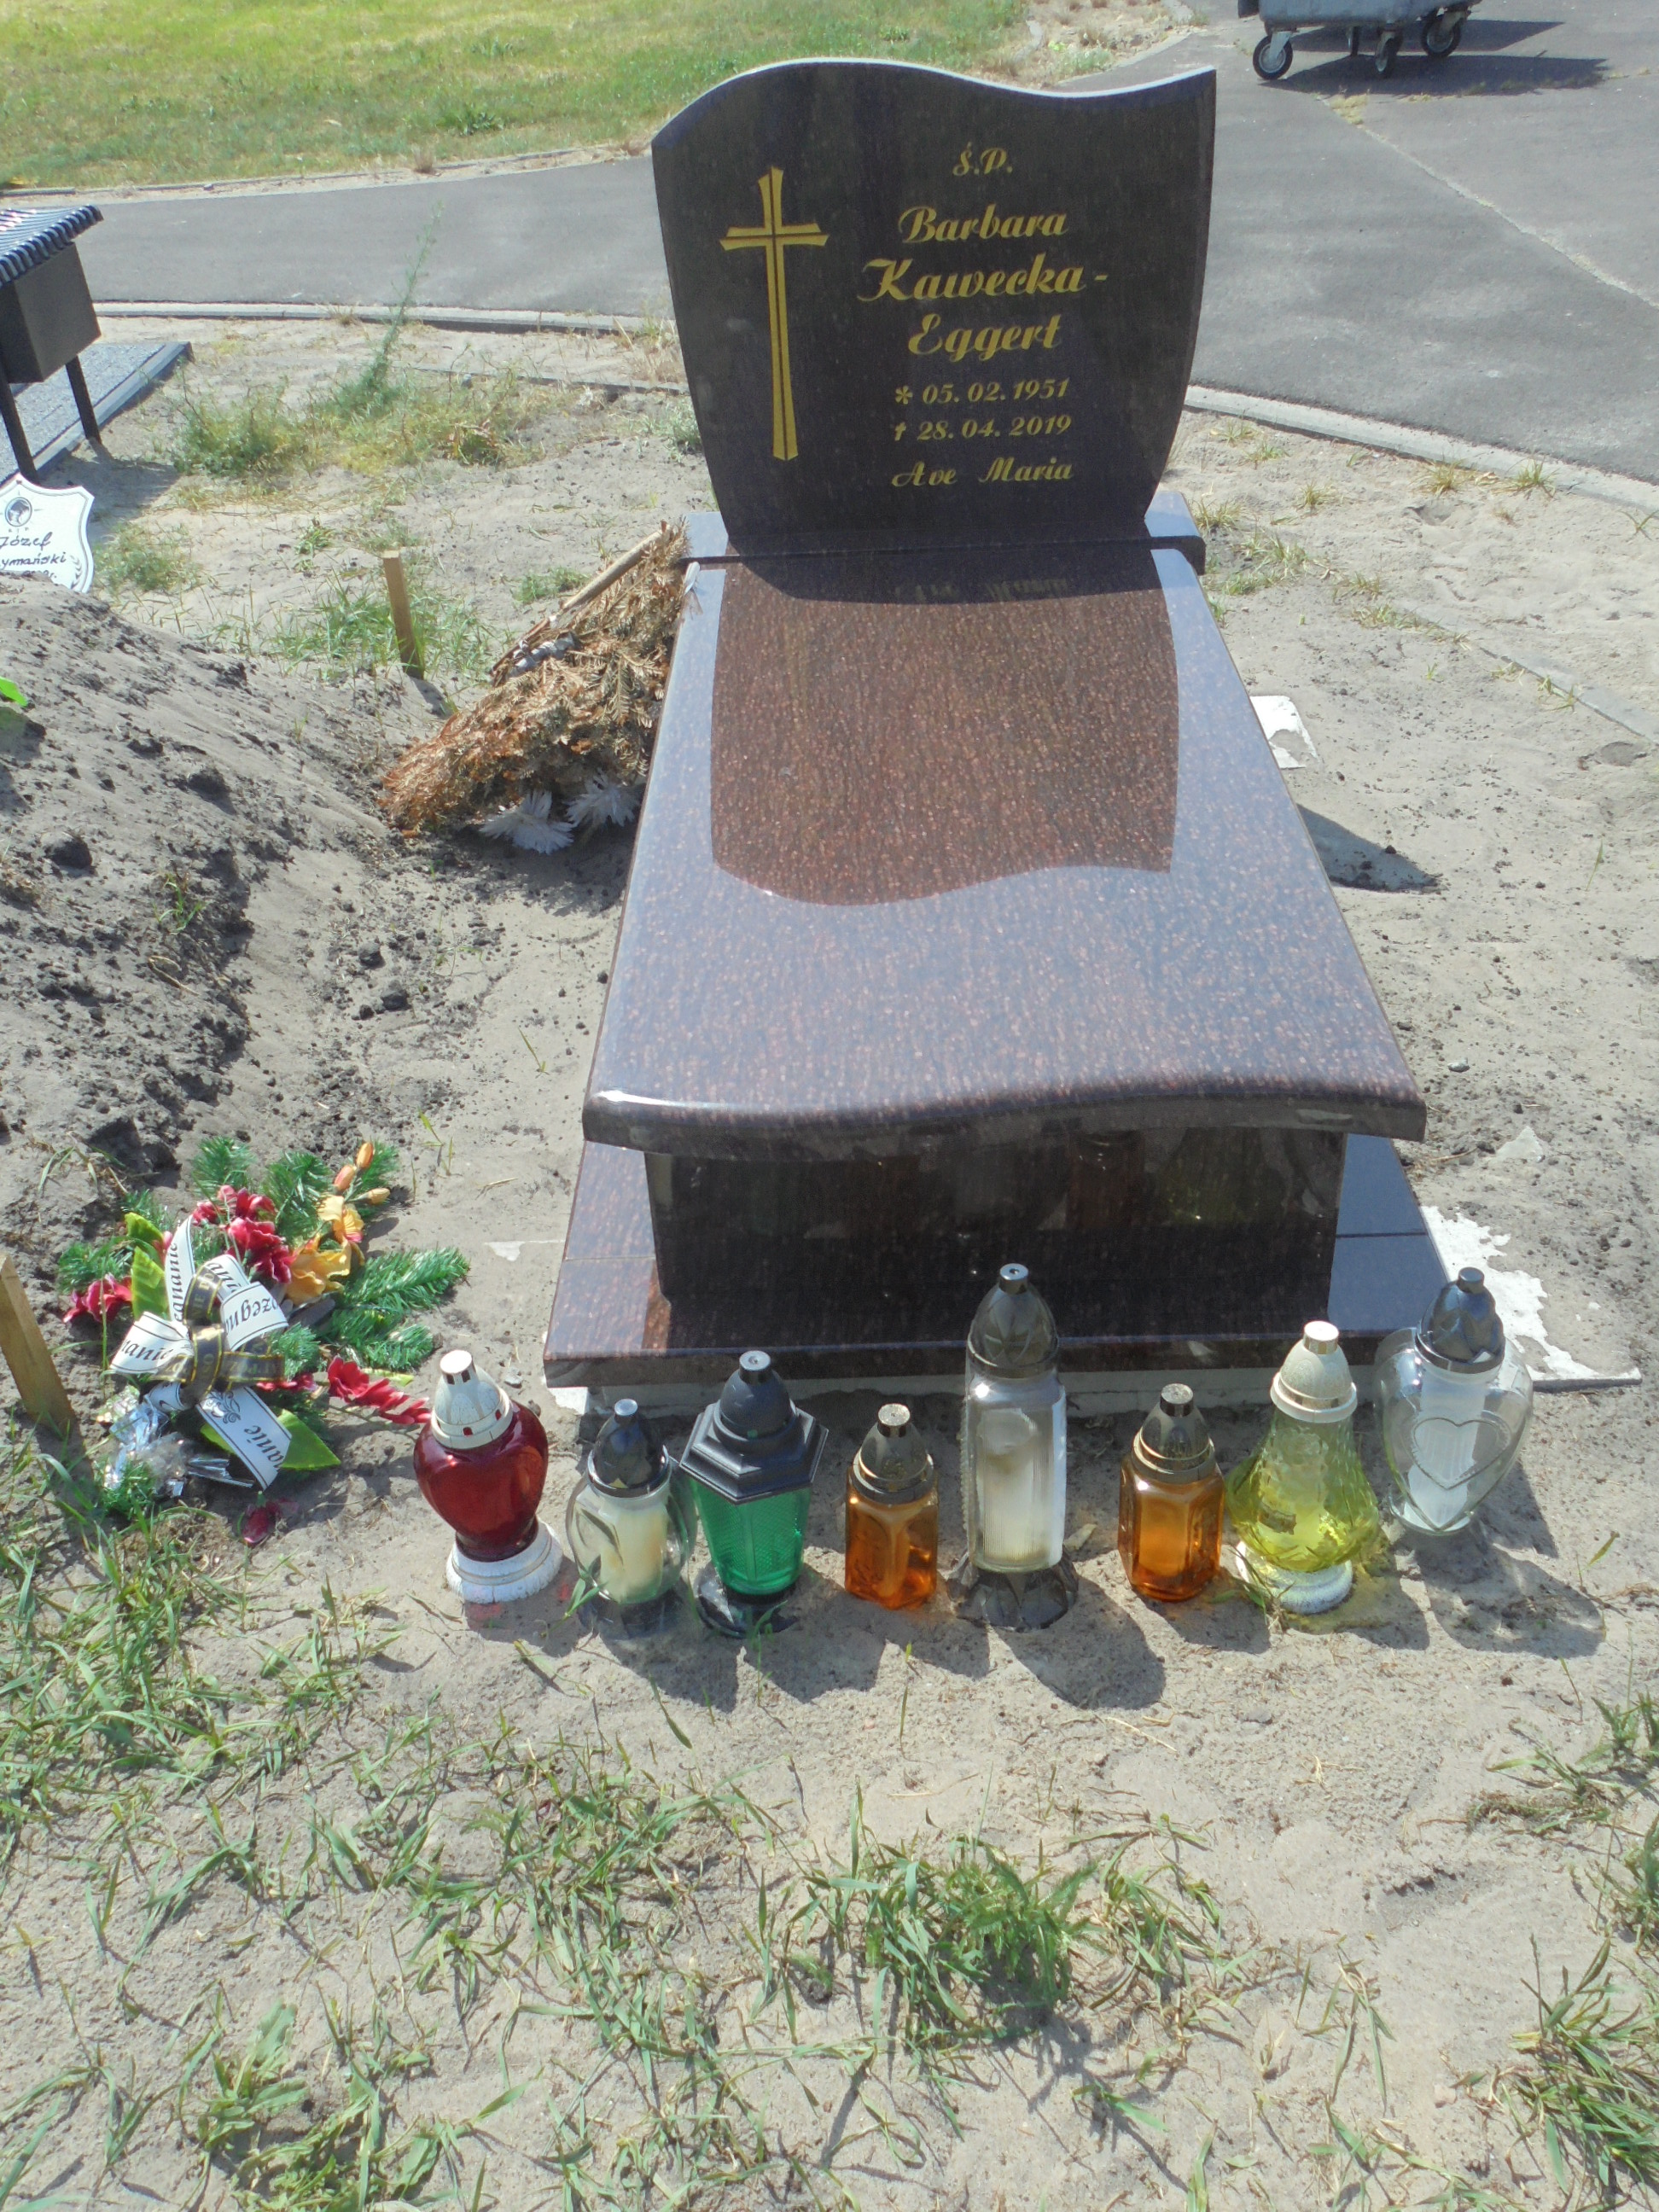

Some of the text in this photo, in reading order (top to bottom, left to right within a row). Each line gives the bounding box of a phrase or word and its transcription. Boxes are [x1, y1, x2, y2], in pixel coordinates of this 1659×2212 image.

[899, 204, 1069, 243] Barbara
[908, 313, 1062, 362] Eggert
[892, 457, 1074, 486] Ave Maria
